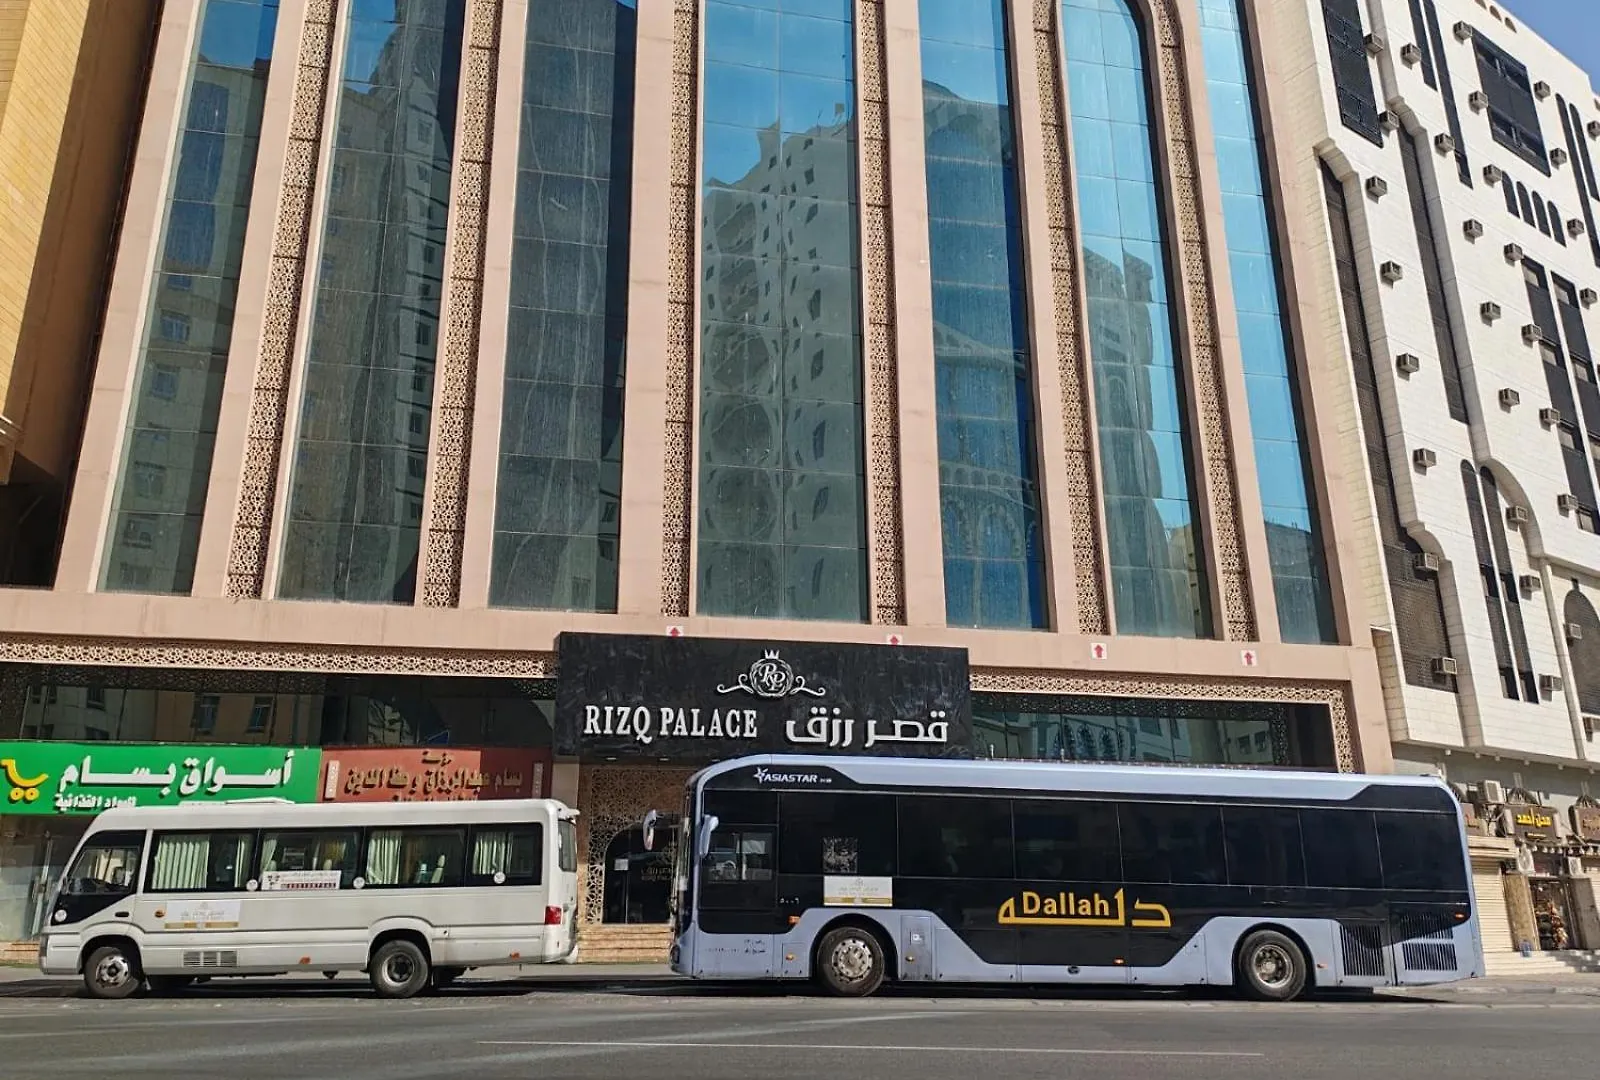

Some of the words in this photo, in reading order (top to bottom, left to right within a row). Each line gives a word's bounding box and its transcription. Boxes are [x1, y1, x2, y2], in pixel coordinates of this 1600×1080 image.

[584, 705, 652, 744] RIZQ
[659, 707, 757, 738] PALACE
[786, 706, 854, 747] رزق
[865, 710, 948, 747] قصر
[59, 755, 177, 796] بسام
[180, 749, 295, 795] أسواق
[763, 773, 818, 784] ASIASTAR
[1022, 891, 1110, 917] Dallah
